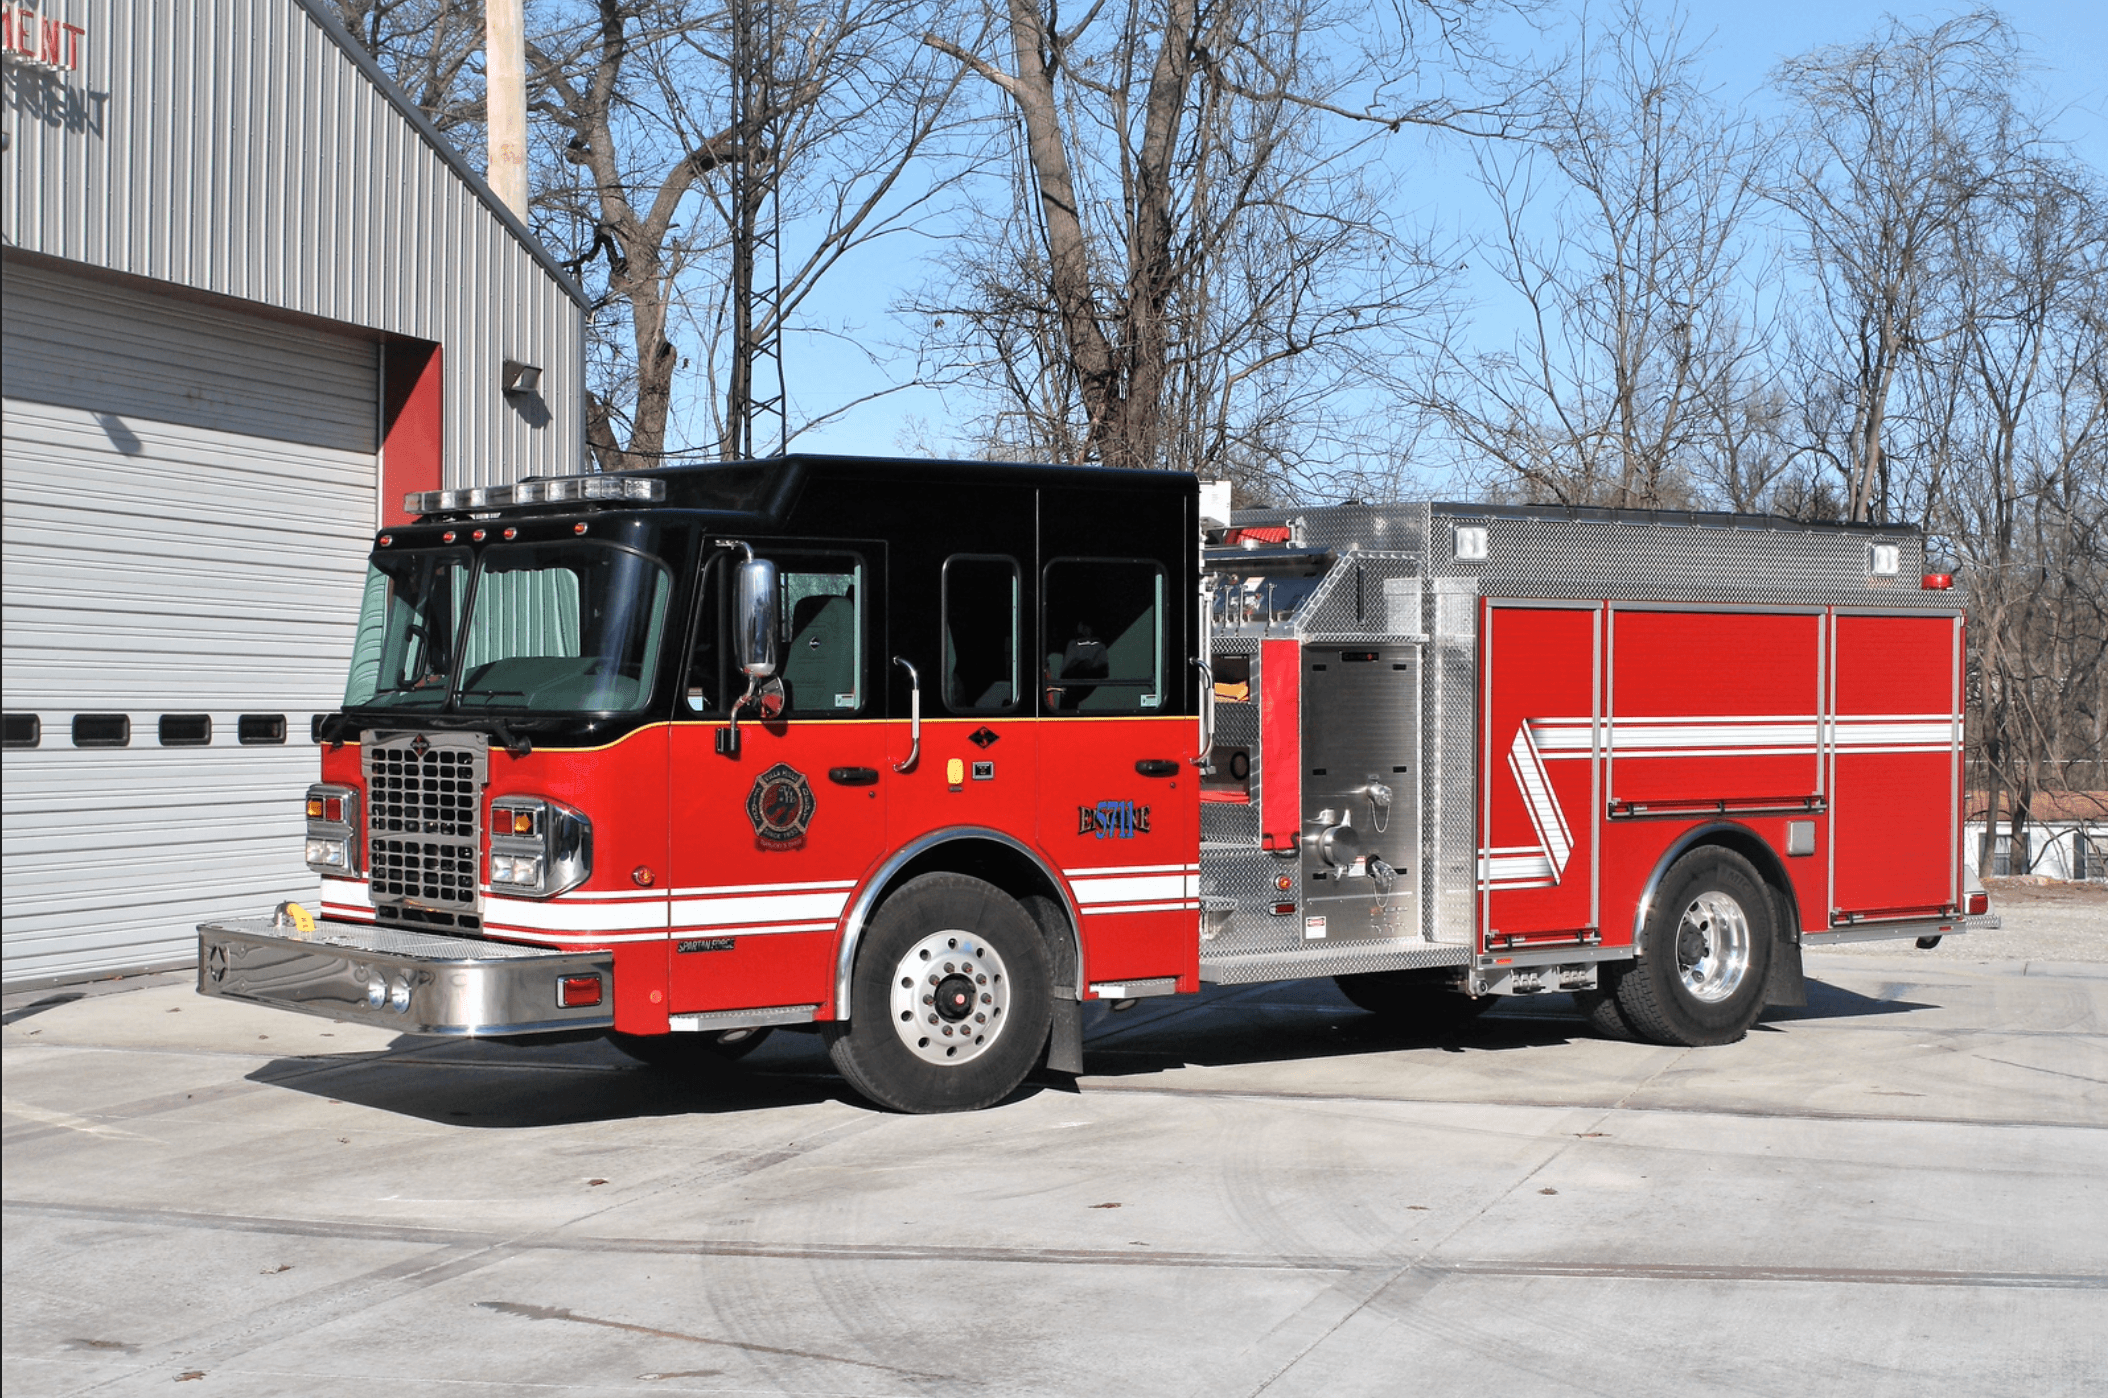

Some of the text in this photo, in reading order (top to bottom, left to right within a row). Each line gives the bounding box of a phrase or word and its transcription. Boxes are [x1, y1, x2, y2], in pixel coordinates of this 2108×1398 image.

[751, 787, 761, 821] FIRE
[802, 787, 810, 821] DEPT
[1078, 805, 1151, 835] ENNE
[1096, 800, 1134, 840] 5711
[678, 940, 711, 953] SPARTAN
